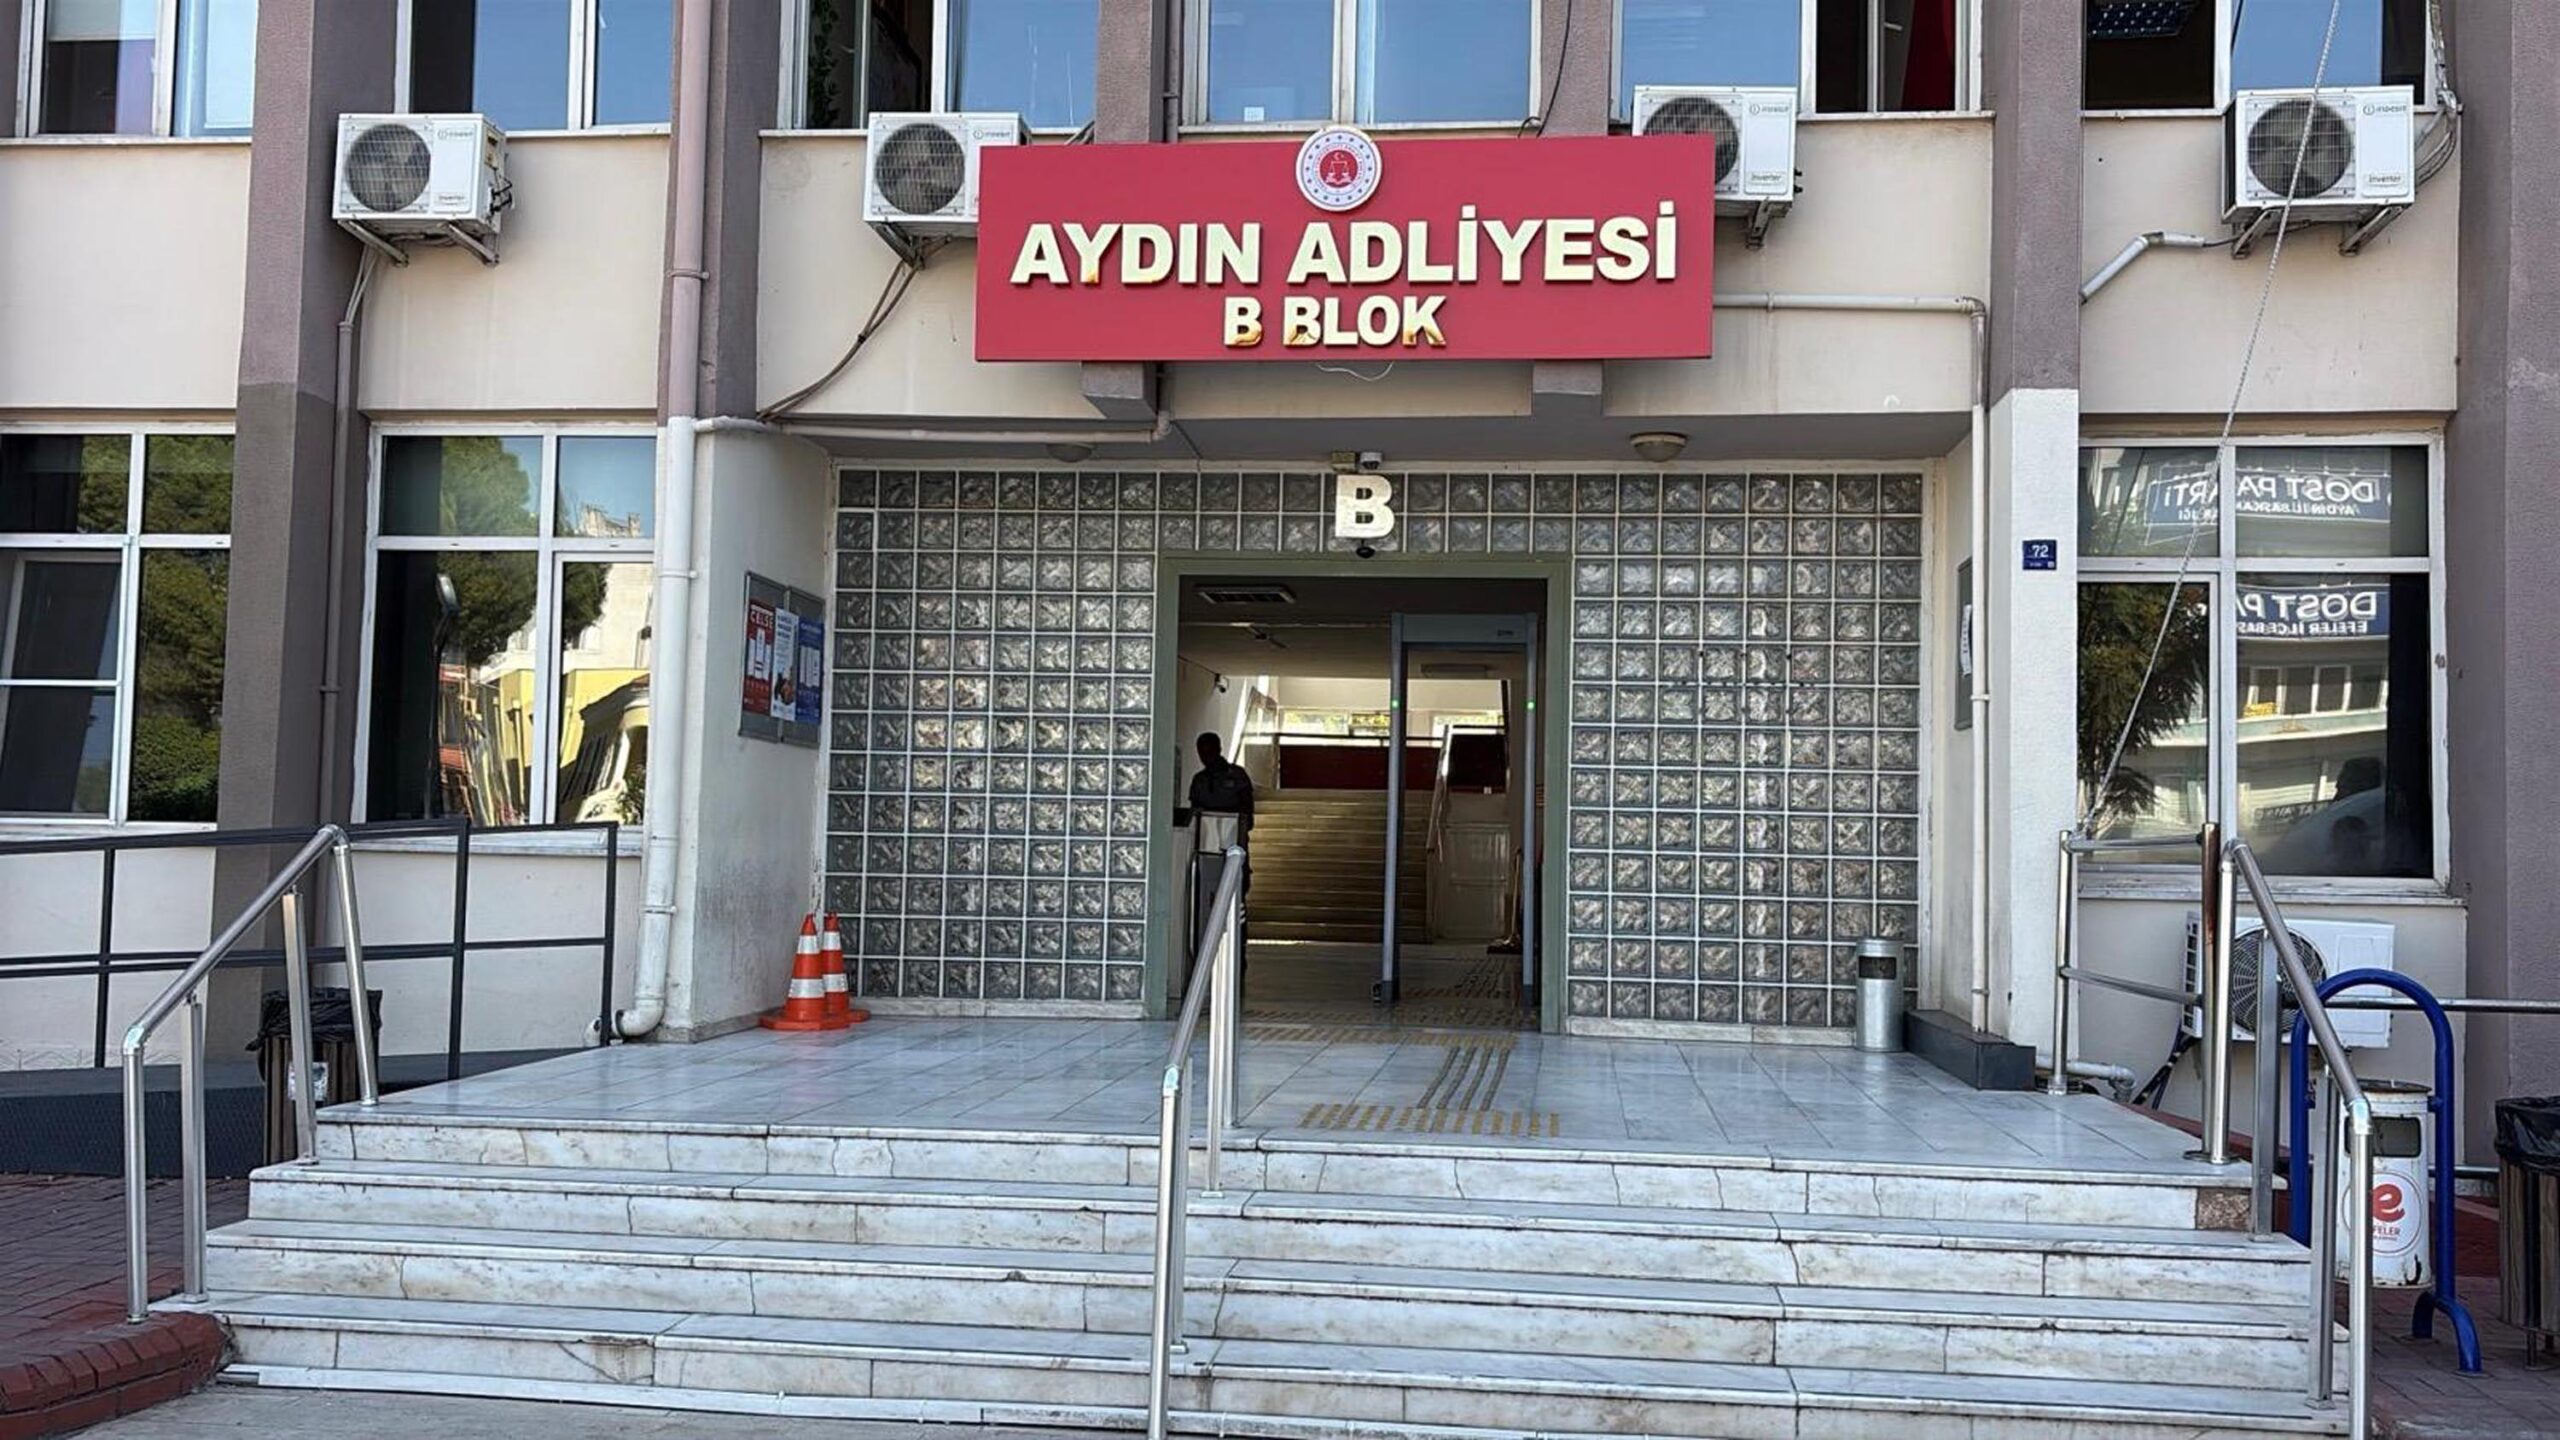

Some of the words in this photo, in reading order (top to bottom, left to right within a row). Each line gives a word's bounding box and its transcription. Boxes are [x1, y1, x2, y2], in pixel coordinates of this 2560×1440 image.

[1010, 221, 1260, 285] AYDIN
[1287, 200, 1676, 285] ADLİYESİ
[1224, 296, 1263, 346] B
[1283, 295, 1447, 347] BLOK
[1335, 474, 1395, 538] B
[2031, 544, 2050, 558] 72
